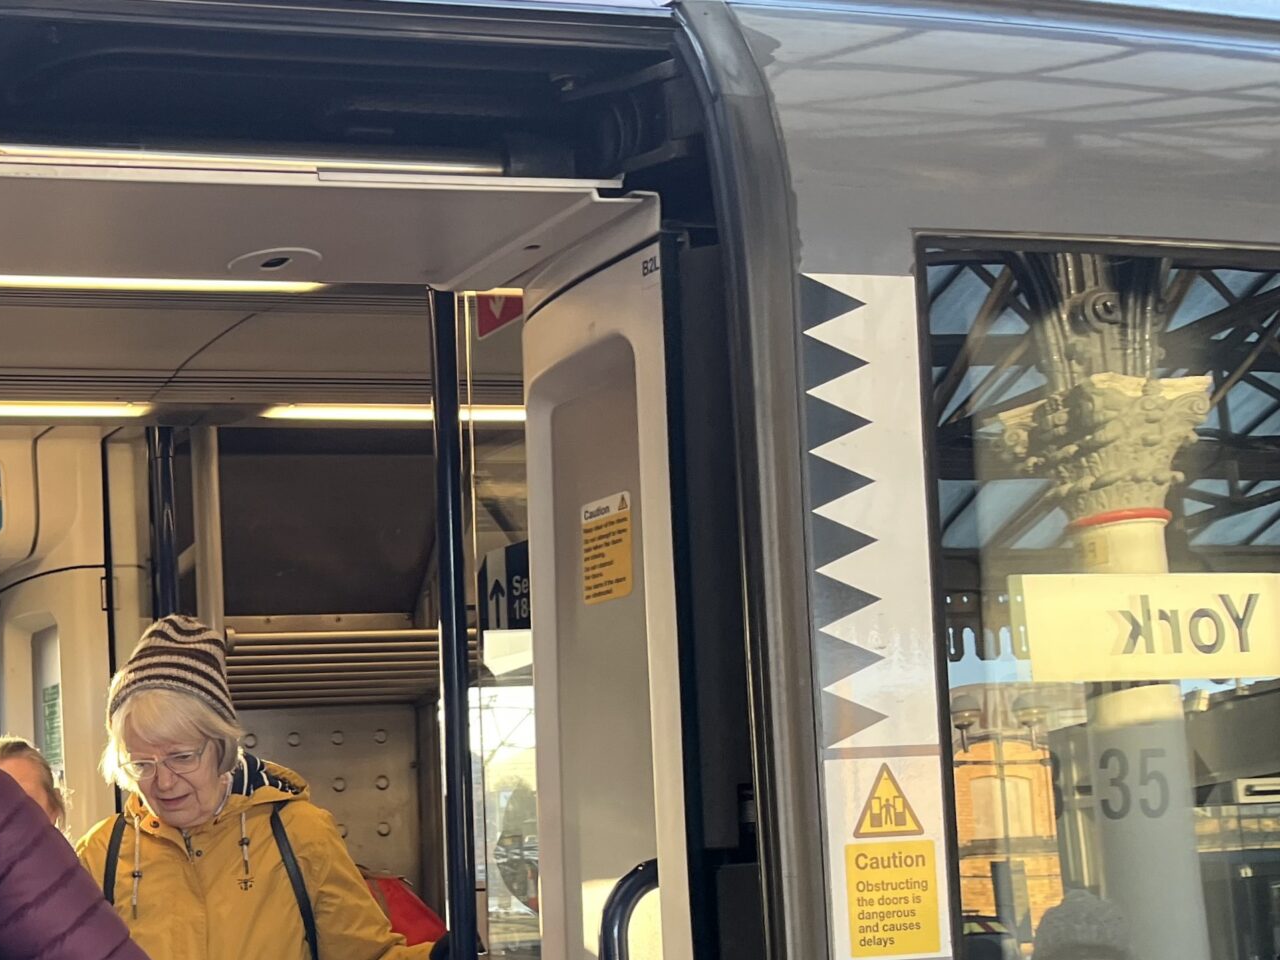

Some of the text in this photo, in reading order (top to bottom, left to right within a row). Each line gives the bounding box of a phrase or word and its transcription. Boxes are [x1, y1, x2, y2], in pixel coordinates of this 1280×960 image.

[583, 505, 611, 521] Caution
[855, 851, 926, 870] Caution
[856, 878, 929, 892] Obstructing
[857, 893, 922, 907] the doors is
[858, 909, 916, 921] dangerous
[858, 921, 921, 934] and causes
[859, 936, 895, 948] delays
